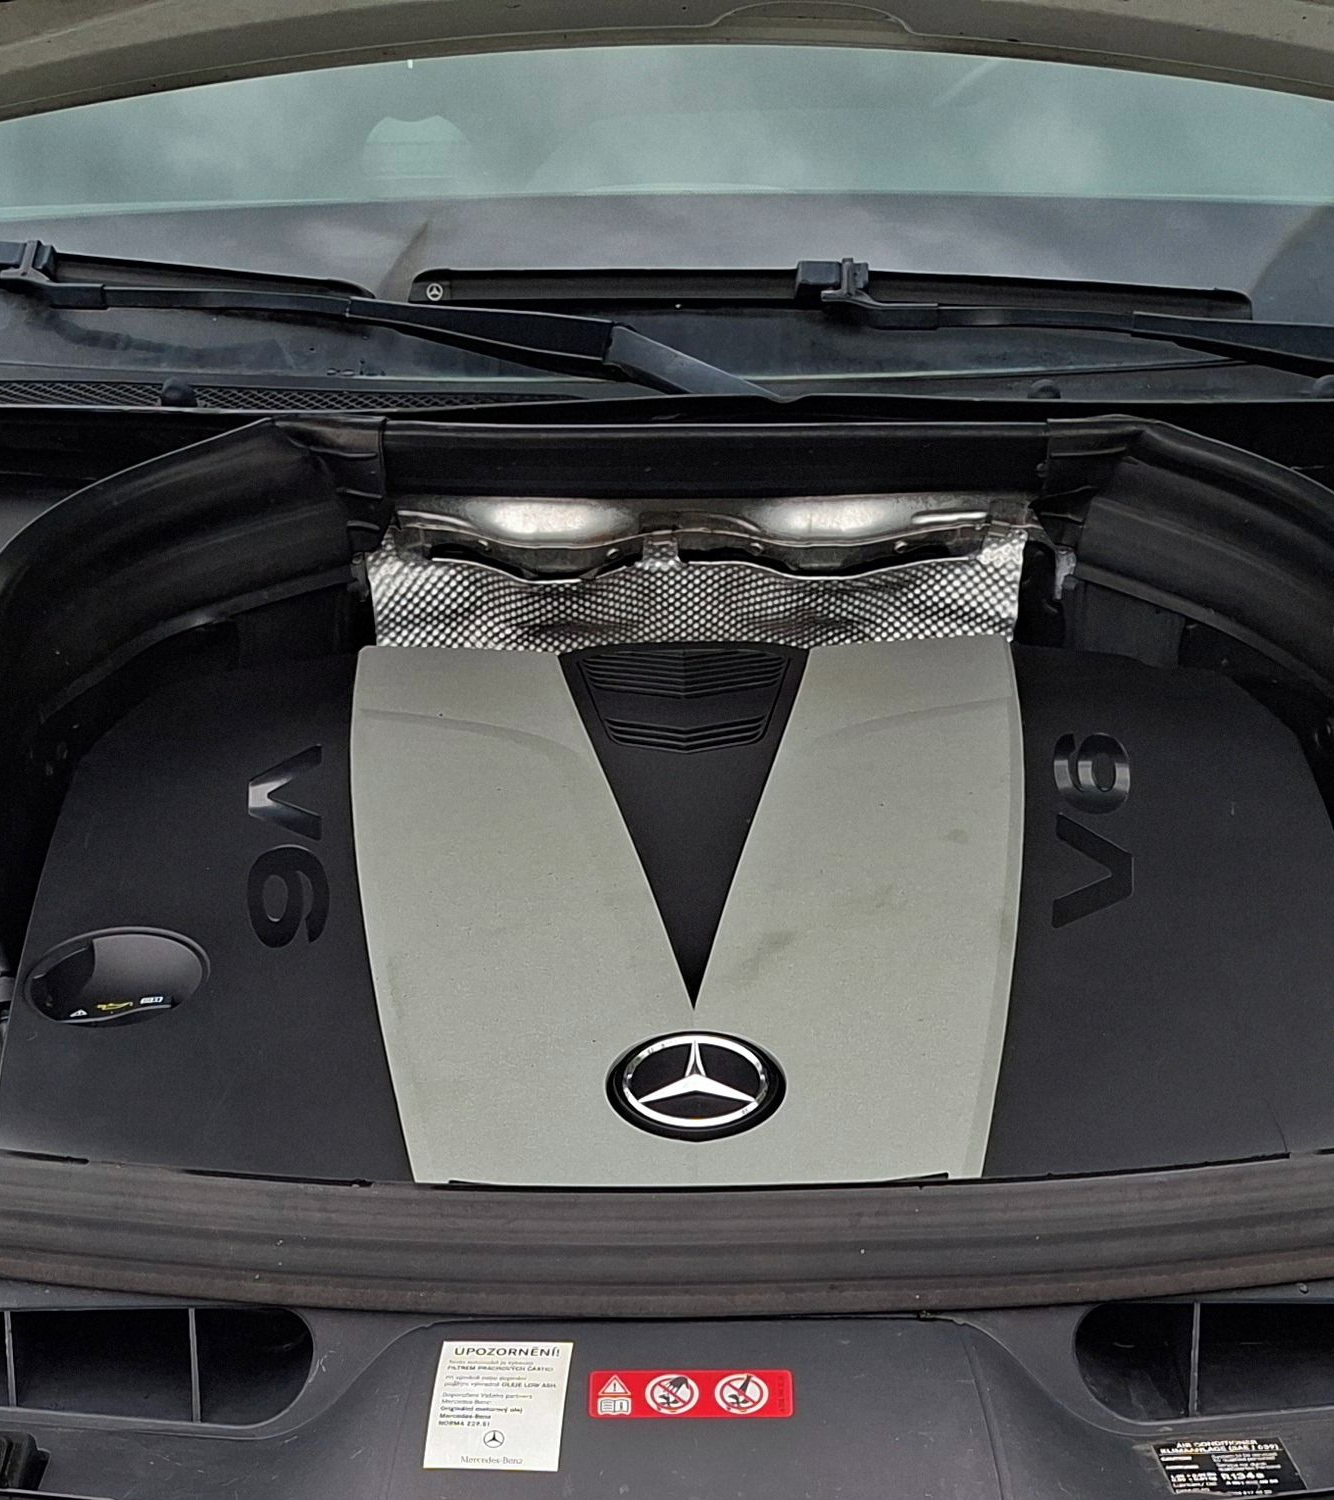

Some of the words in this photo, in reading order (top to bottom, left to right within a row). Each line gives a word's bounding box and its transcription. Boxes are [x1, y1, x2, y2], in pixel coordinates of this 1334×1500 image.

[248, 744, 330, 948] V6
[1051, 732, 1134, 928] V6
[454, 1346, 560, 1357] UPOZORNĚNÍ!
